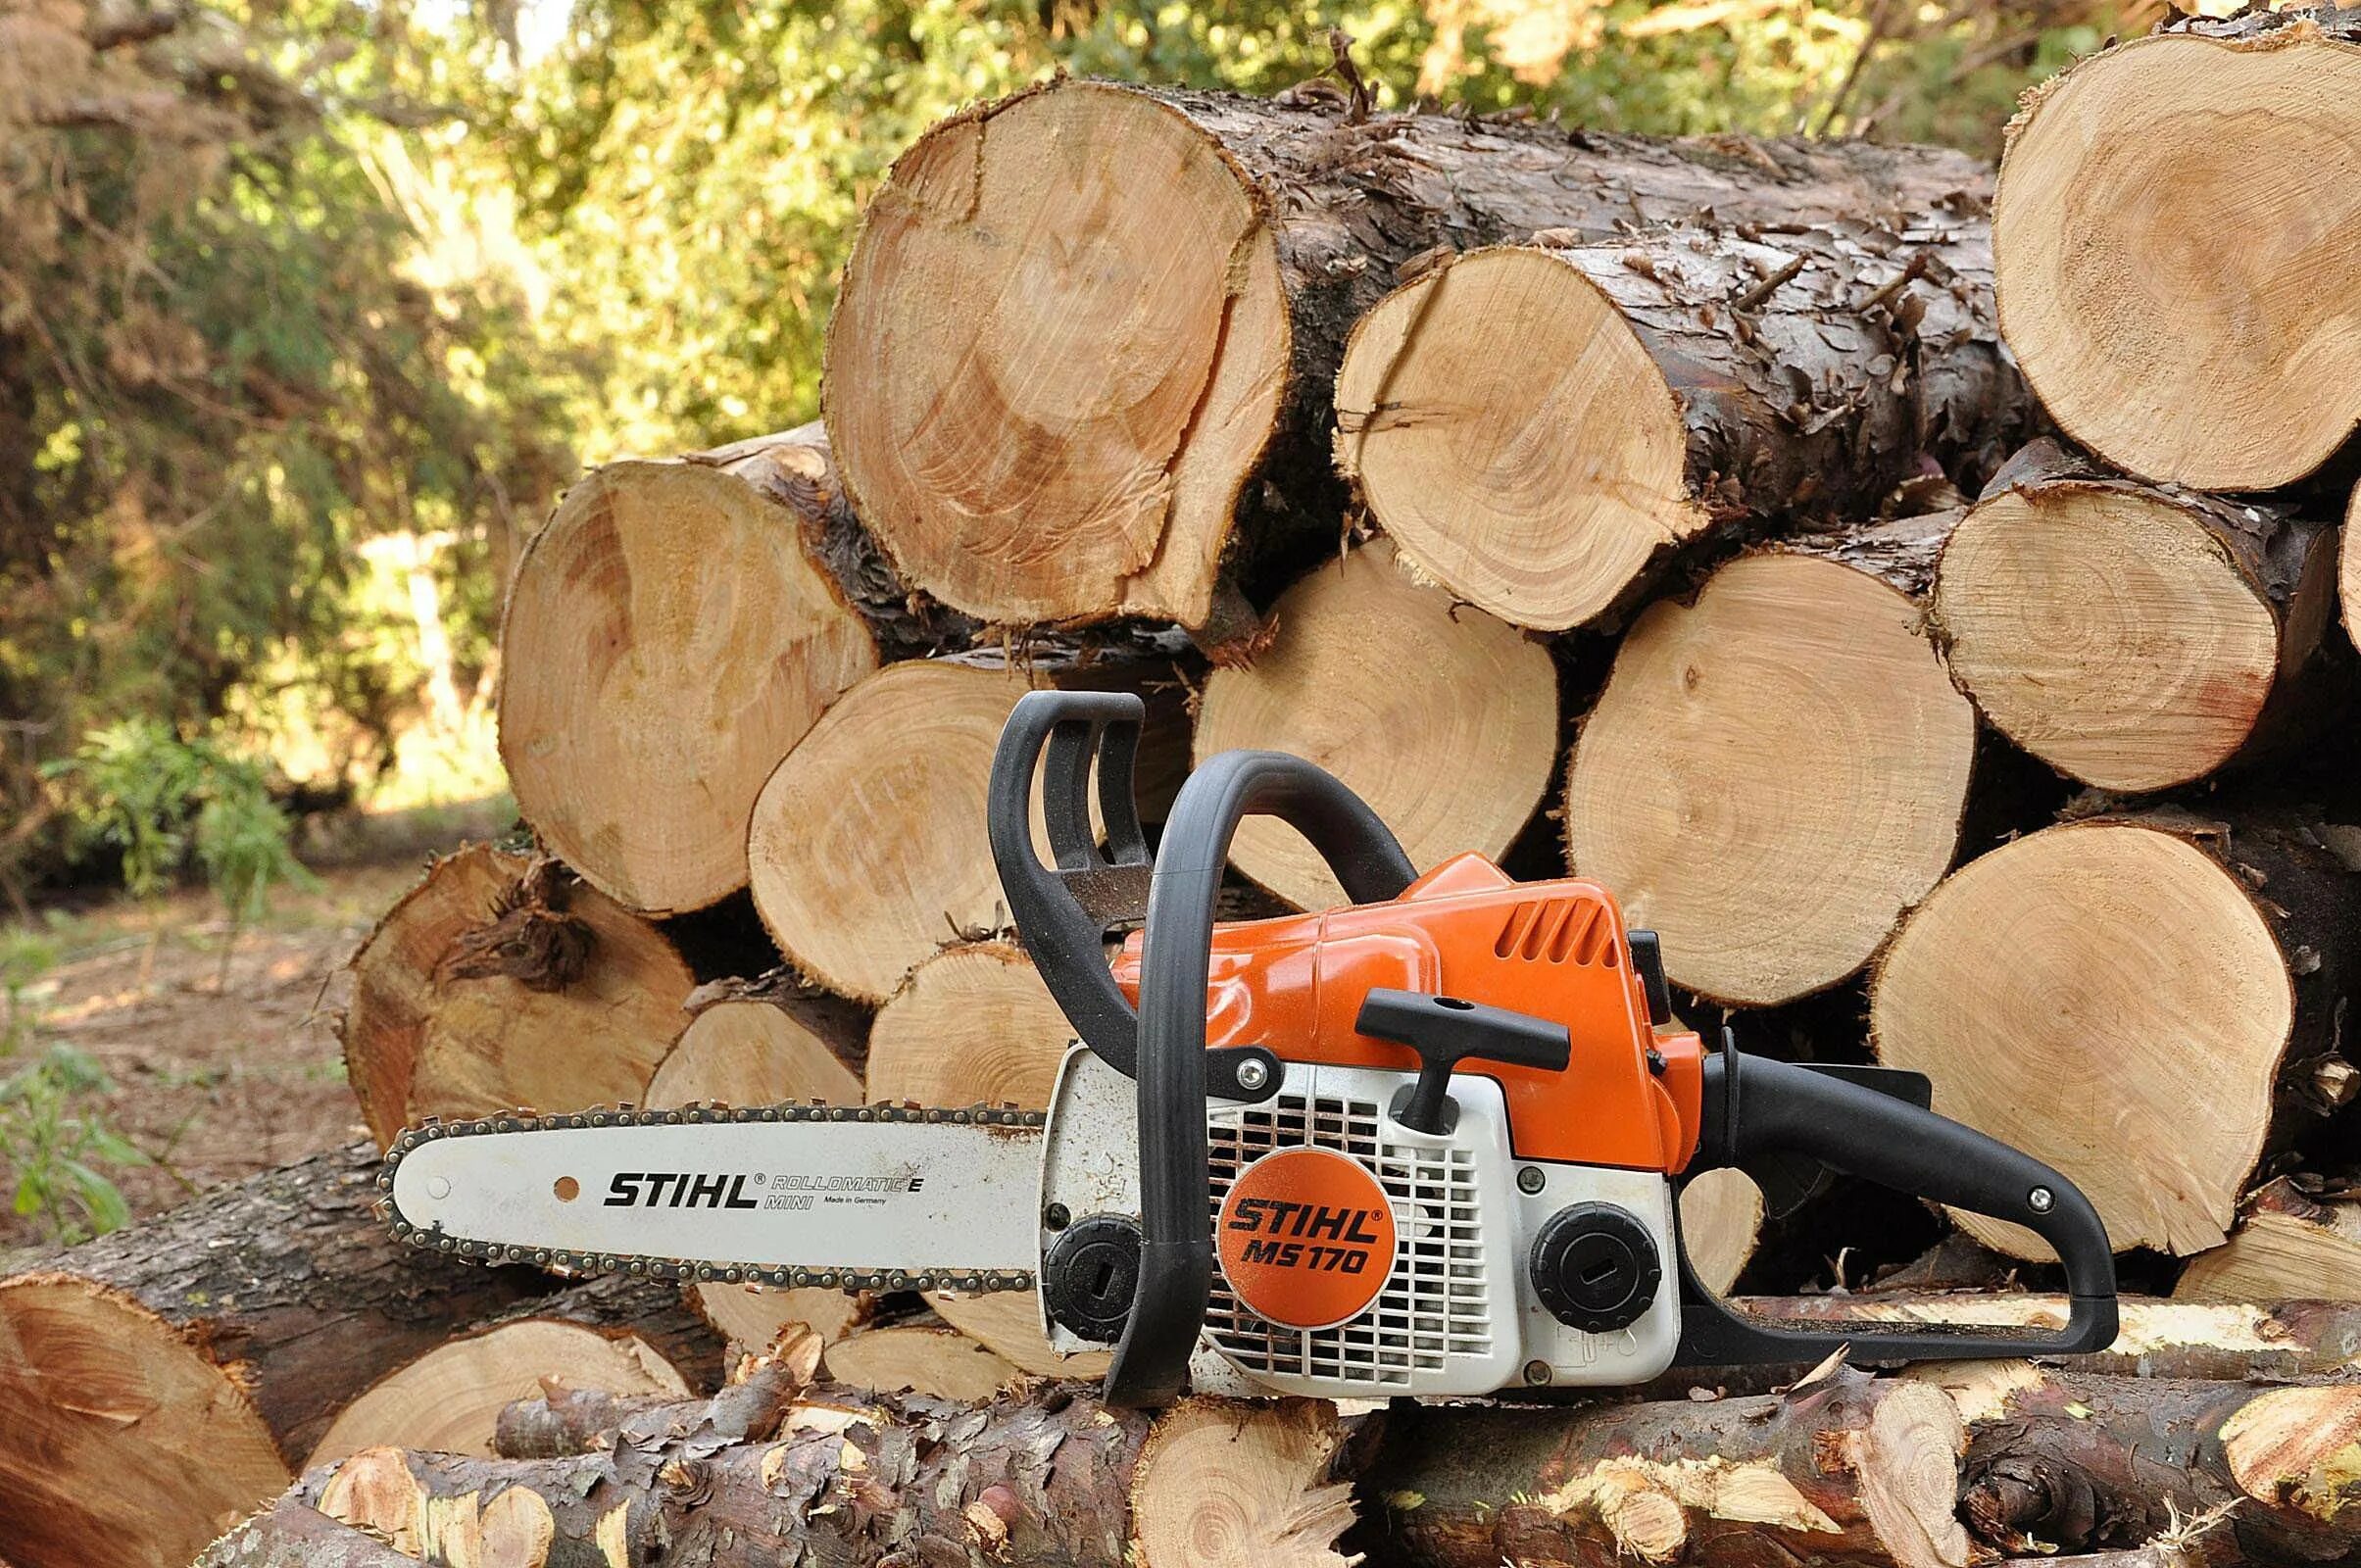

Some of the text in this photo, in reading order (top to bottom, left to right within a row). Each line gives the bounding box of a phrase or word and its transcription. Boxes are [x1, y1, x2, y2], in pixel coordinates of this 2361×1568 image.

[908, 1178, 924, 1192] E
[763, 1195, 814, 1209] MINI
[824, 1196, 886, 1205] Made in Germany
[1241, 1239, 1369, 1274] MS 170
